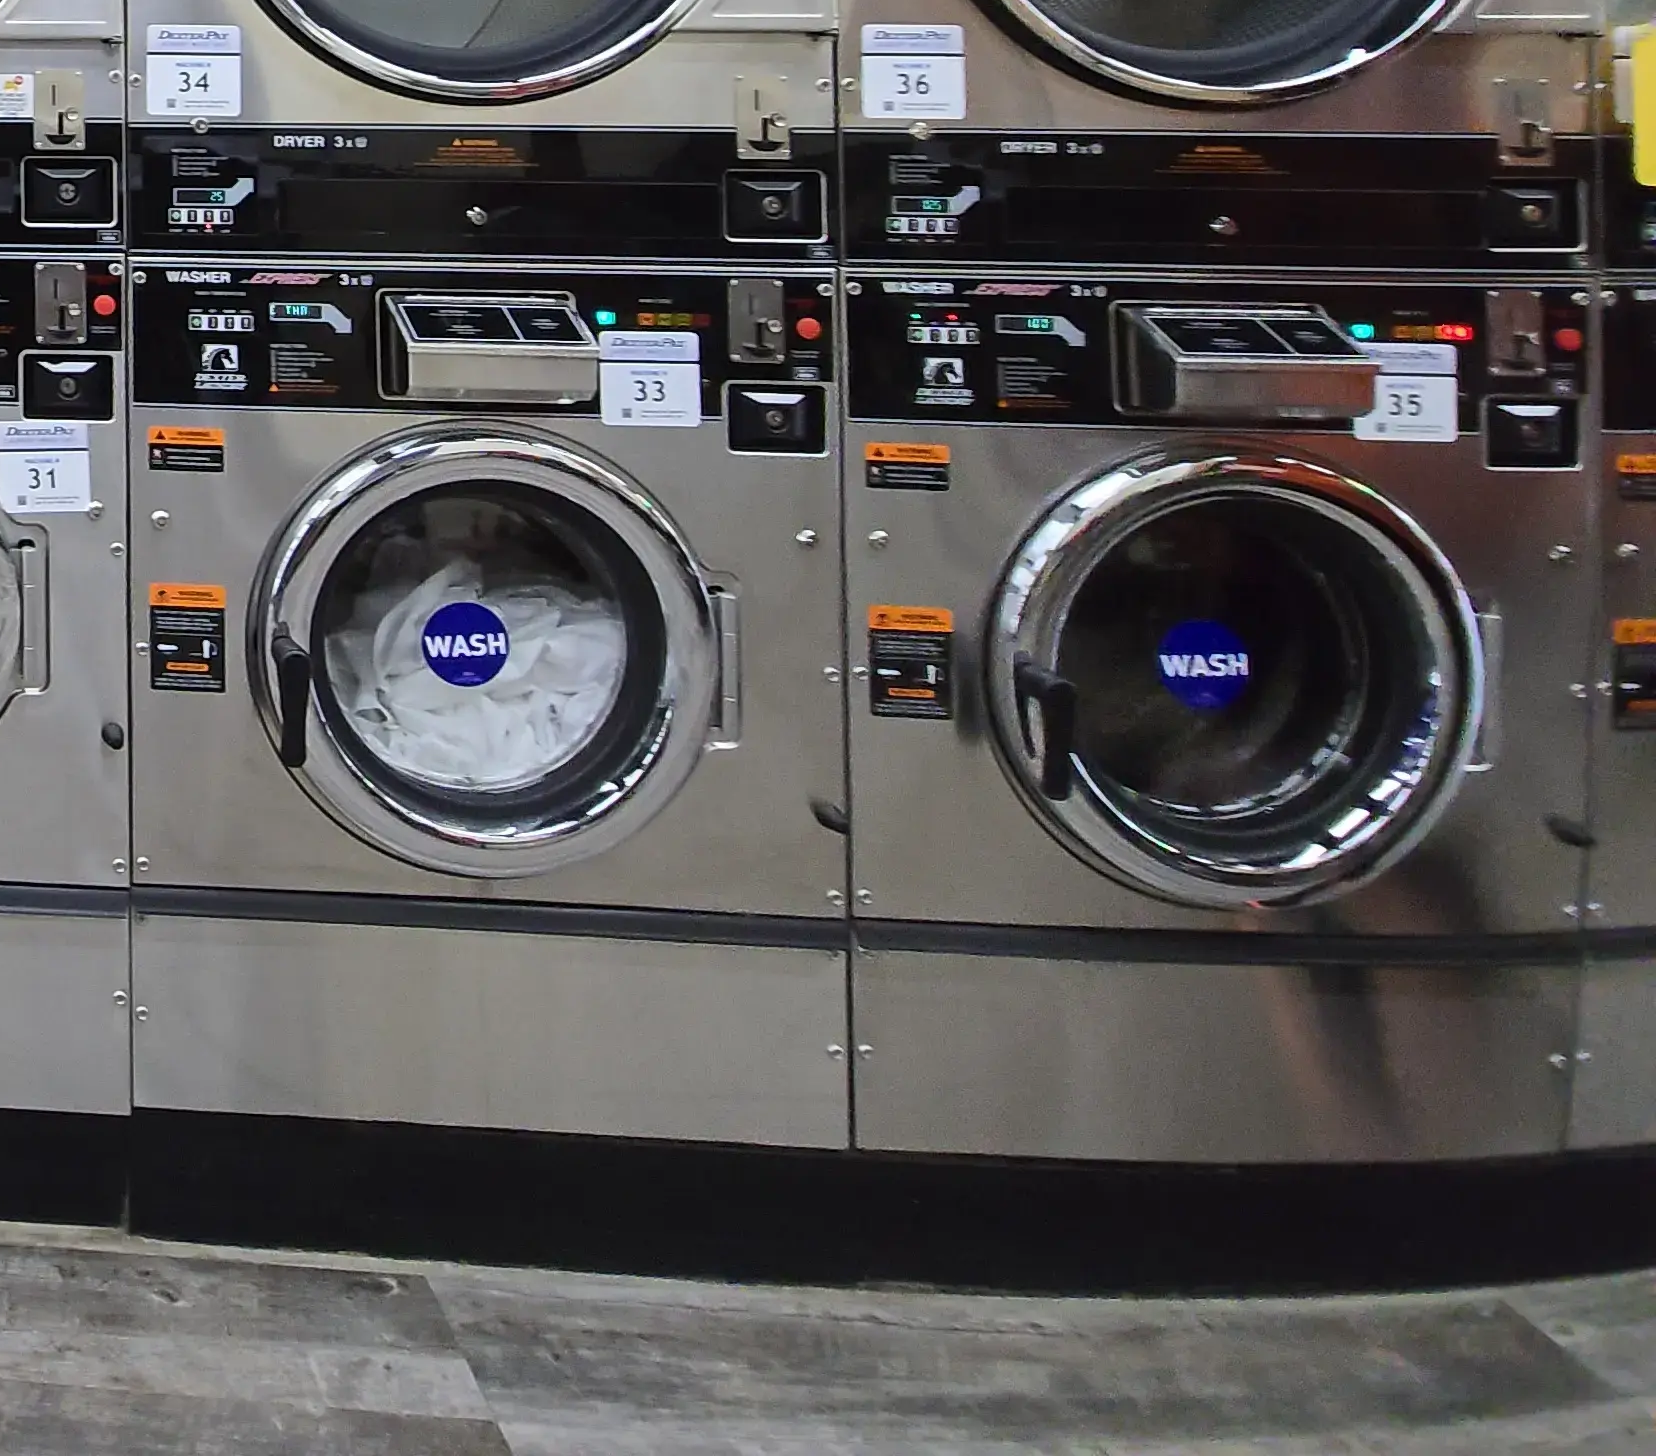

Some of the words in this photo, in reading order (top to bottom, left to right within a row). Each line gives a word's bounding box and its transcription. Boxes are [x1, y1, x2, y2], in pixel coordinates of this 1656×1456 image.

[178, 71, 210, 93] 34
[897, 73, 930, 95] 36
[273, 135, 325, 148] DRYER
[210, 191, 224, 202] 25
[165, 271, 231, 284] WASHER
[633, 380, 665, 402] 33
[1387, 394, 1422, 416] 35
[28, 468, 58, 490] 31
[425, 633, 507, 658] WASH
[1159, 653, 1249, 677] WASH
